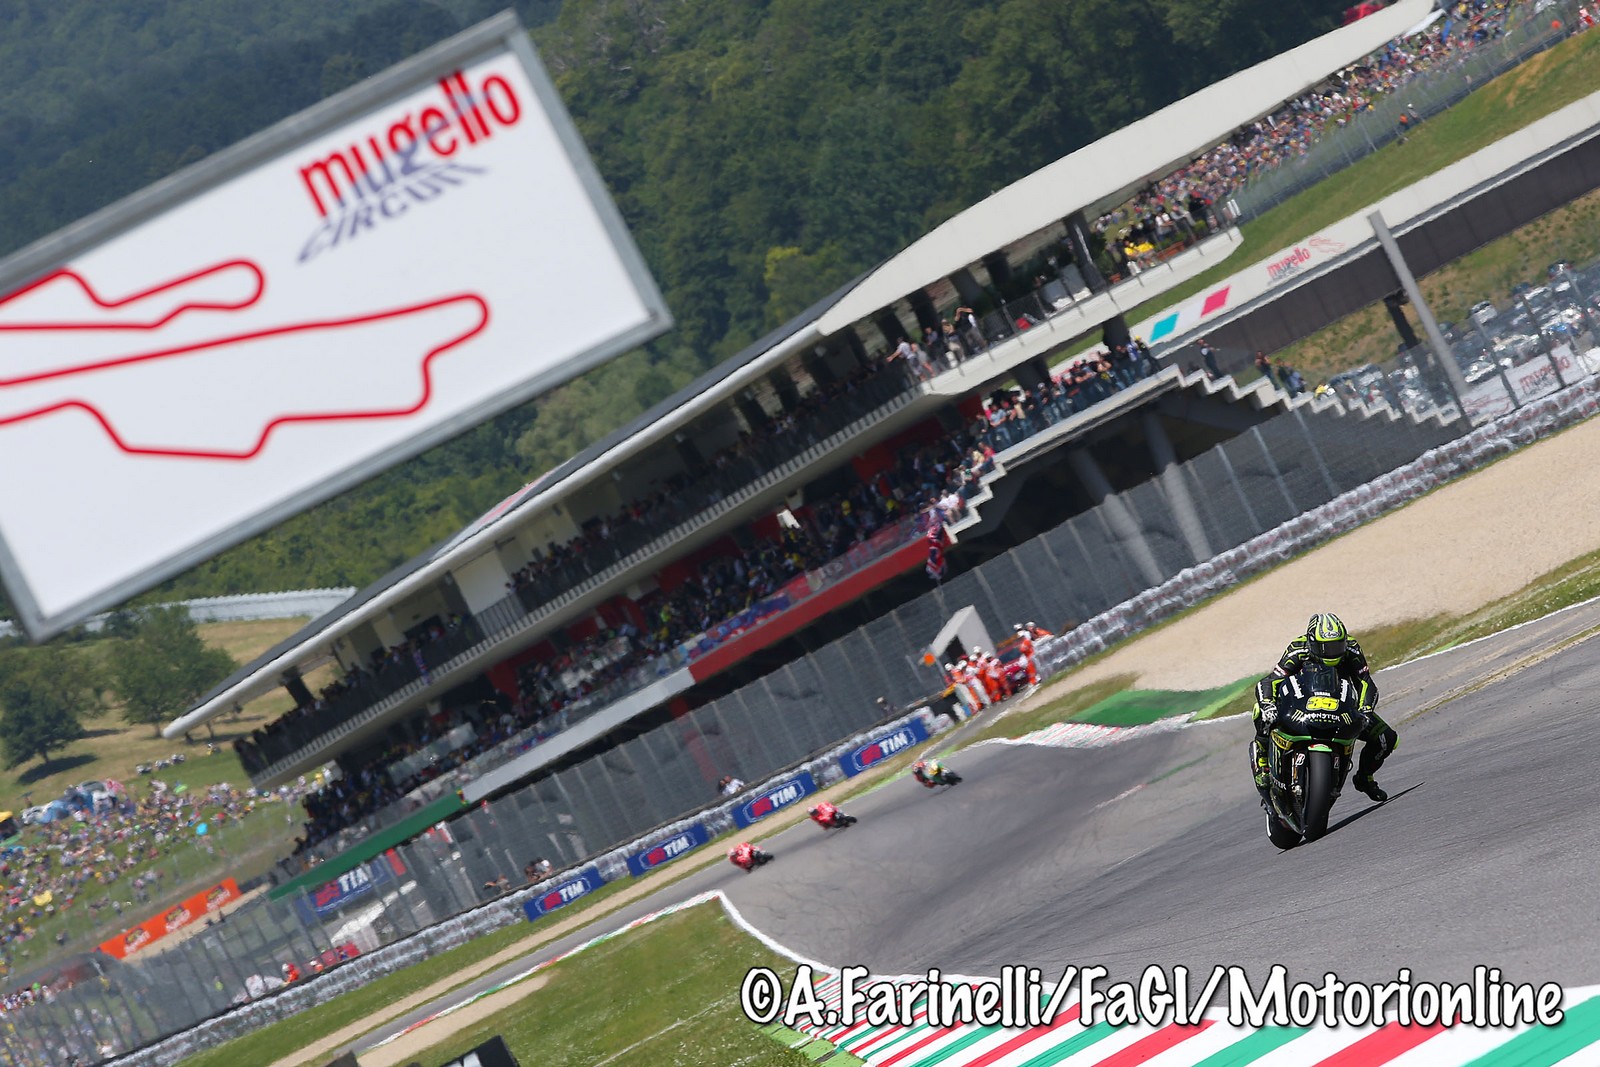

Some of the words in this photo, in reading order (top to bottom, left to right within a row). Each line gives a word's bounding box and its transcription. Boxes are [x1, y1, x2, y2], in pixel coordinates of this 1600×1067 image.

[298, 68, 521, 217] mugello
[1306, 696, 1340, 711] 35
[878, 731, 909, 754] TIM
[769, 785, 798, 808] TIM
[664, 835, 690, 858] TIM
[560, 879, 586, 902] TIM
